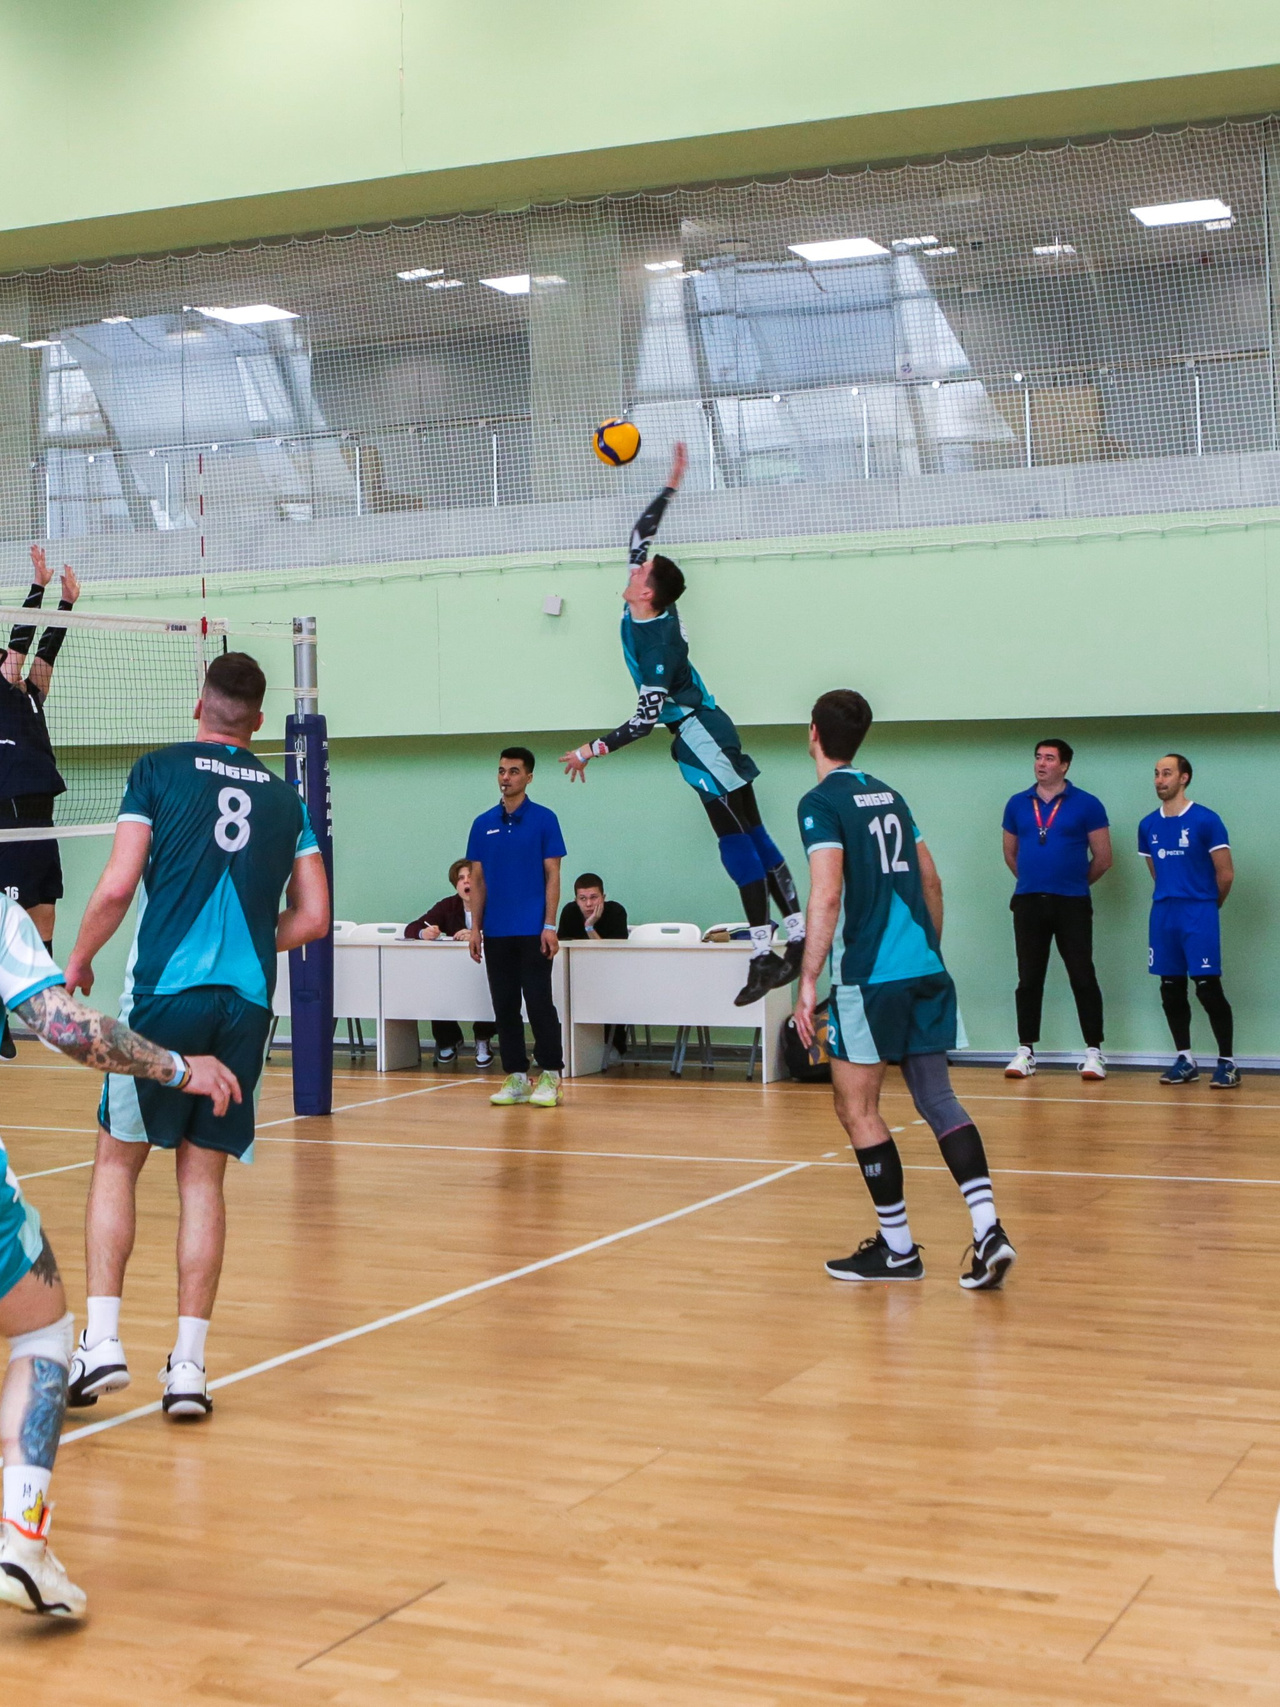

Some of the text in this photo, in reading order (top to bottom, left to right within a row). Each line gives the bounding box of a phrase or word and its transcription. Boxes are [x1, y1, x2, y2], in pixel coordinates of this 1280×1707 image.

[195, 757, 271, 783] СИБУР
[853, 791, 895, 808] СИБУР
[214, 786, 252, 853] 8
[868, 813, 910, 874] 12
[4, 885, 19, 900] 16
